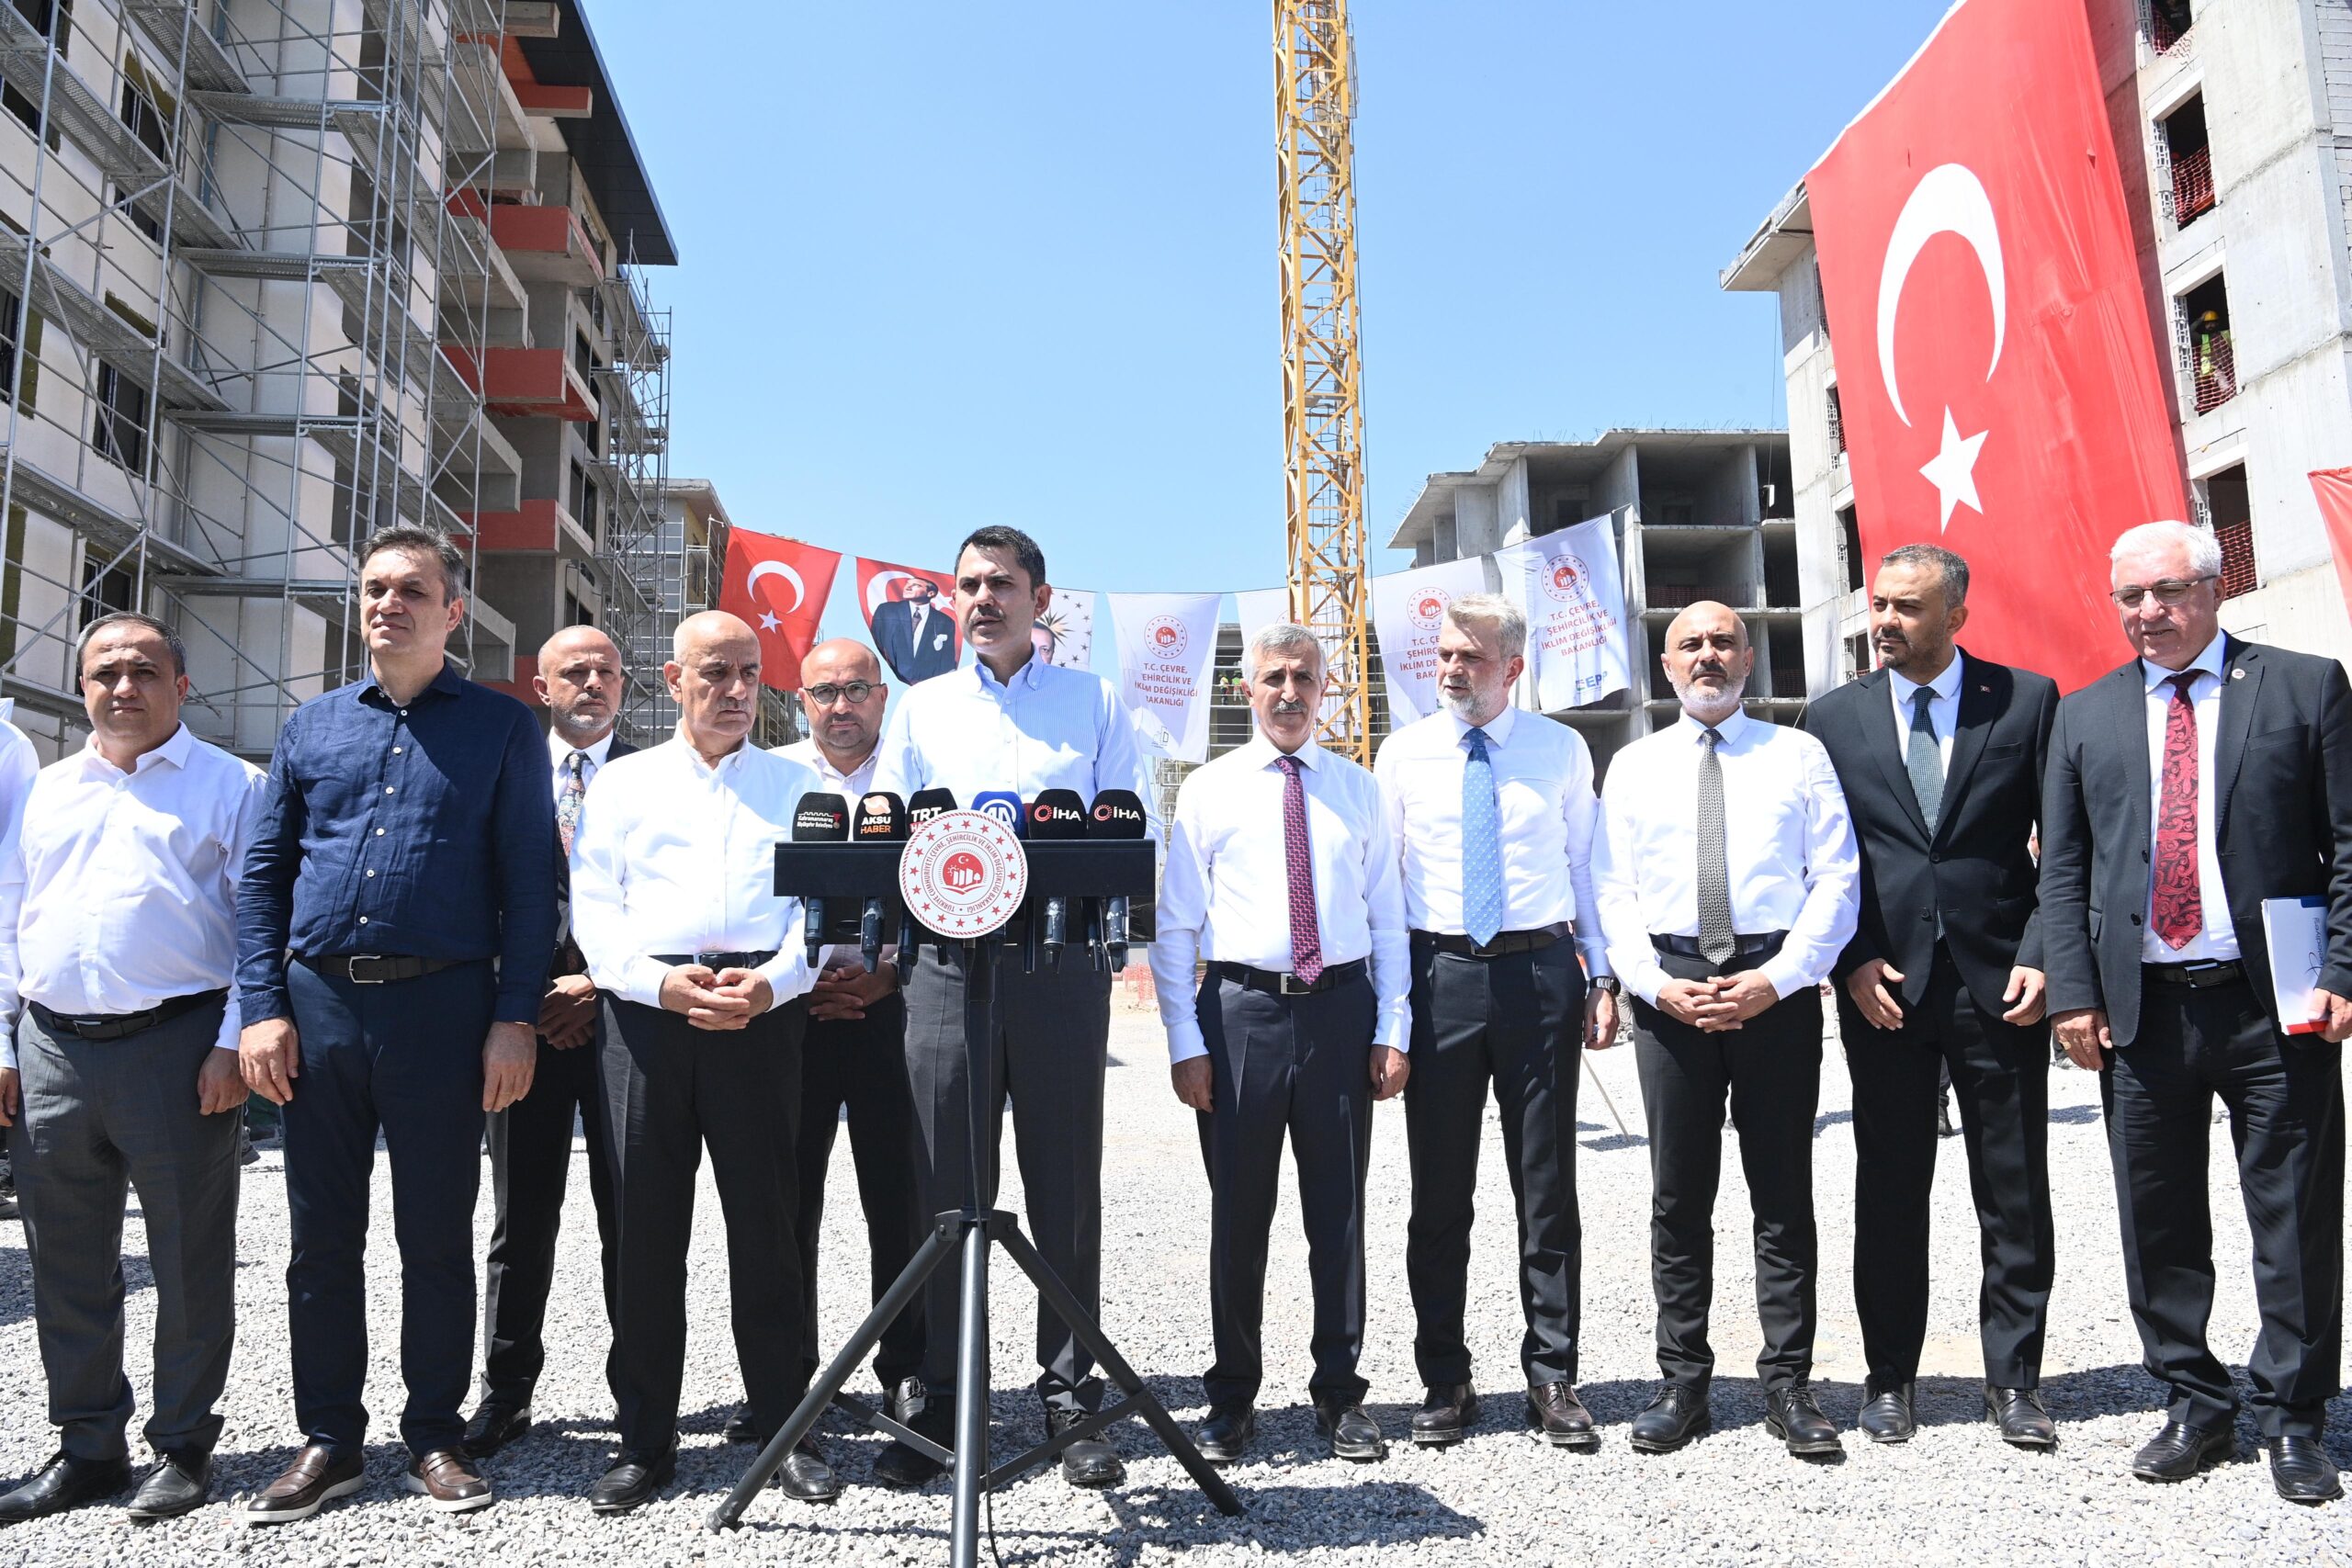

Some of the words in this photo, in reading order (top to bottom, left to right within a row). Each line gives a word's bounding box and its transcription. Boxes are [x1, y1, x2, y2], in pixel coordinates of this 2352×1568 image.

[1551, 611, 1567, 621] T.C.
[1547, 613, 1596, 637] ŞEHİRCİLİK
[1597, 609, 1609, 618] VE
[1541, 637, 1567, 650] İKLİM
[1561, 636, 1607, 656] BAKANLIĞI
[1407, 647, 1438, 660] ŞEHİRC
[1144, 662, 1159, 671] T.C.
[1159, 664, 1188, 674] ÇEVRE,
[1400, 660, 1424, 671] İKLİM
[1141, 672, 1181, 684] EHİRCİLİK
[1182, 677, 1192, 685] VE
[862, 816, 891, 825] AKSU
[910, 807, 942, 823] TRT
[1053, 807, 1081, 821] İHA
[1113, 807, 1141, 821] İHA
[860, 825, 891, 834] HABER
[945, 833, 978, 844] ŞEHİRCİLİK
[978, 838, 987, 846] VE
[984, 842, 998, 859] İKLİM
[923, 856, 936, 897] CUMHURİYETİ
[933, 896, 955, 912] TÜRKİYE
[967, 892, 996, 913] BAKANLIĞI
